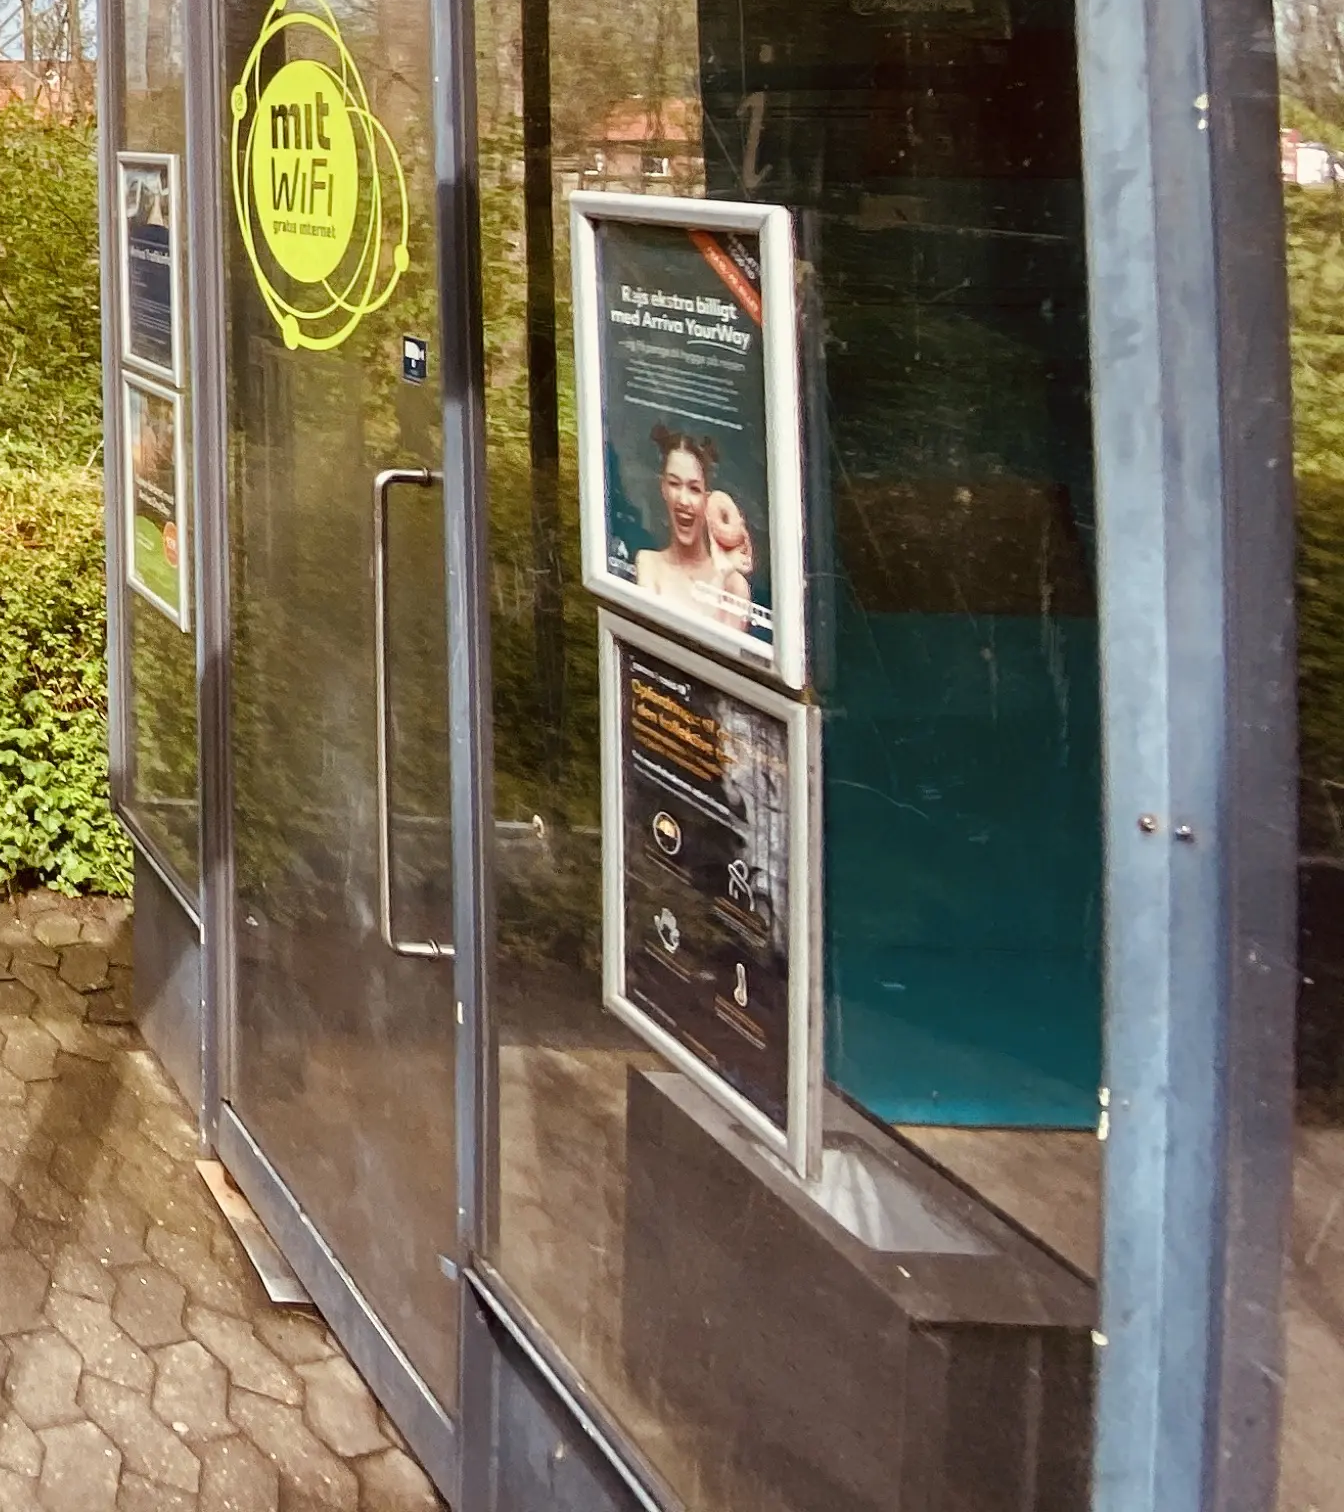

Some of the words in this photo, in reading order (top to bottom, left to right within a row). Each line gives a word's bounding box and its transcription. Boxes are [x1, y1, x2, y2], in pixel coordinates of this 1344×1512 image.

[270, 91, 331, 151] mit
[271, 156, 334, 217] WiFi
[273, 219, 297, 235] gratis
[299, 222, 336, 239] internet
[650, 289, 694, 312] ekstra
[696, 295, 740, 322] billigt
[610, 309, 641, 327] med
[641, 311, 684, 334] Arriva
[685, 317, 751, 351] YourWay
